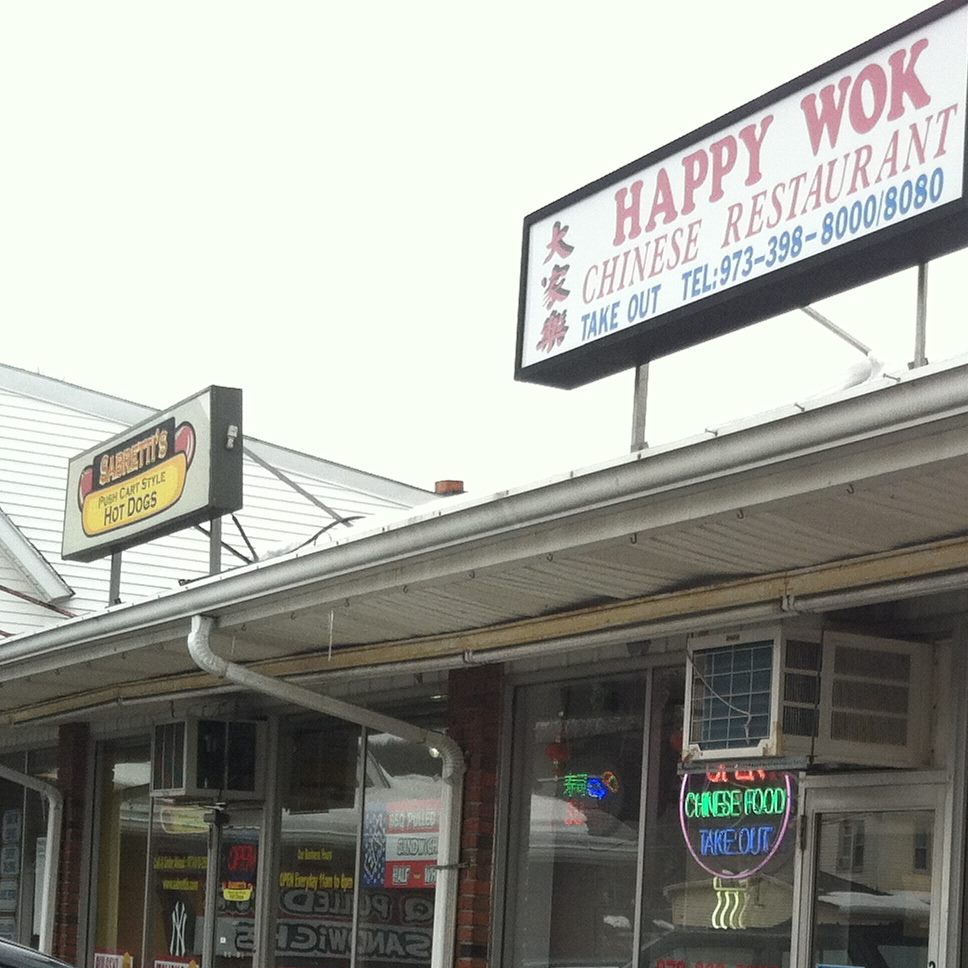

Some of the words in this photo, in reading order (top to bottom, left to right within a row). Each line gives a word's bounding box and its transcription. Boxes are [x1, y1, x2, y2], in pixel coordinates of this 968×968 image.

[612, 114, 774, 246] HAPPY
[800, 38, 931, 157] WOK
[582, 219, 702, 304] CHINESE
[721, 103, 958, 248] RESTAURANT
[581, 301, 620, 341] TAKE
[627, 284, 662, 323] OUT
[119, 486, 140, 500] CART
[141, 471, 167, 491] STYLE
[104, 504, 126, 527] HOT
[128, 491, 158, 517] DOGS
[685, 790, 740, 818] CHINESE
[744, 788, 785, 815] FOOD
[700, 828, 735, 856] TAKE
[739, 826, 773, 855] OUT
